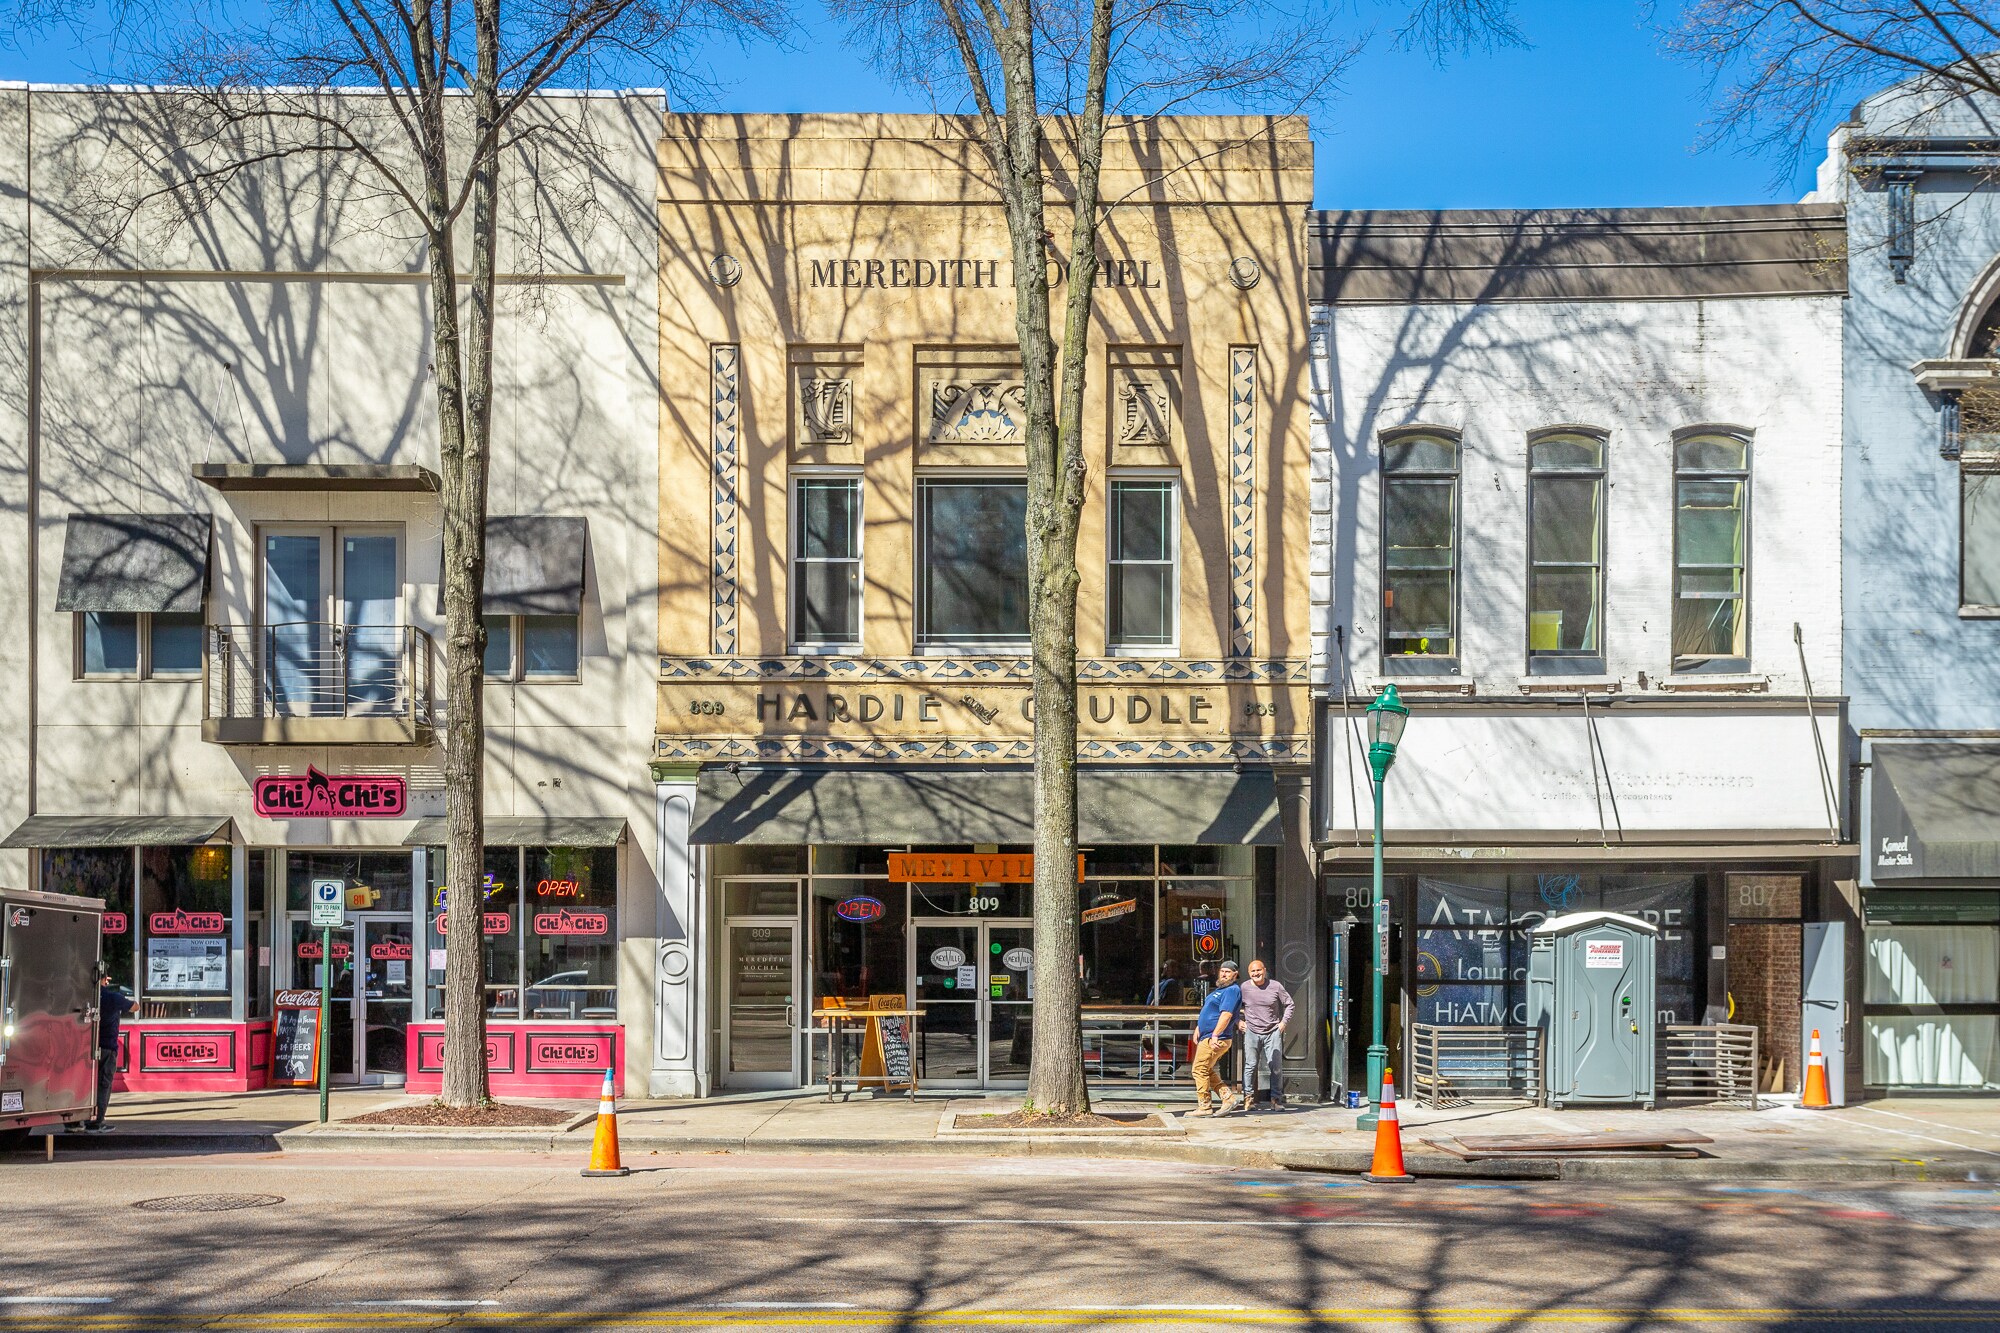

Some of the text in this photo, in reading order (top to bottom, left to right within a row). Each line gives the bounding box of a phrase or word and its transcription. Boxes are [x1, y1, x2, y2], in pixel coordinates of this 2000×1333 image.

[810, 258, 1161, 289] MEREDITH OHEL
[690, 701, 724, 716] 809
[757, 693, 941, 724] HARDIE
[1243, 702, 1278, 716] 809
[262, 784, 397, 808] Chi Chi's
[323, 886, 335, 900] P
[537, 880, 580, 897] OPEN
[1740, 885, 1777, 906] 807
[353, 894, 365, 905] 811
[969, 897, 1000, 911] 809
[837, 901, 881, 917] OPEN
[154, 917, 220, 929] Chi Chi's
[538, 919, 603, 930] Chi Chi's
[752, 928, 771, 938] 809
[160, 1045, 215, 1058] Chi Chi's
[541, 1046, 595, 1059] Chi Chi's
